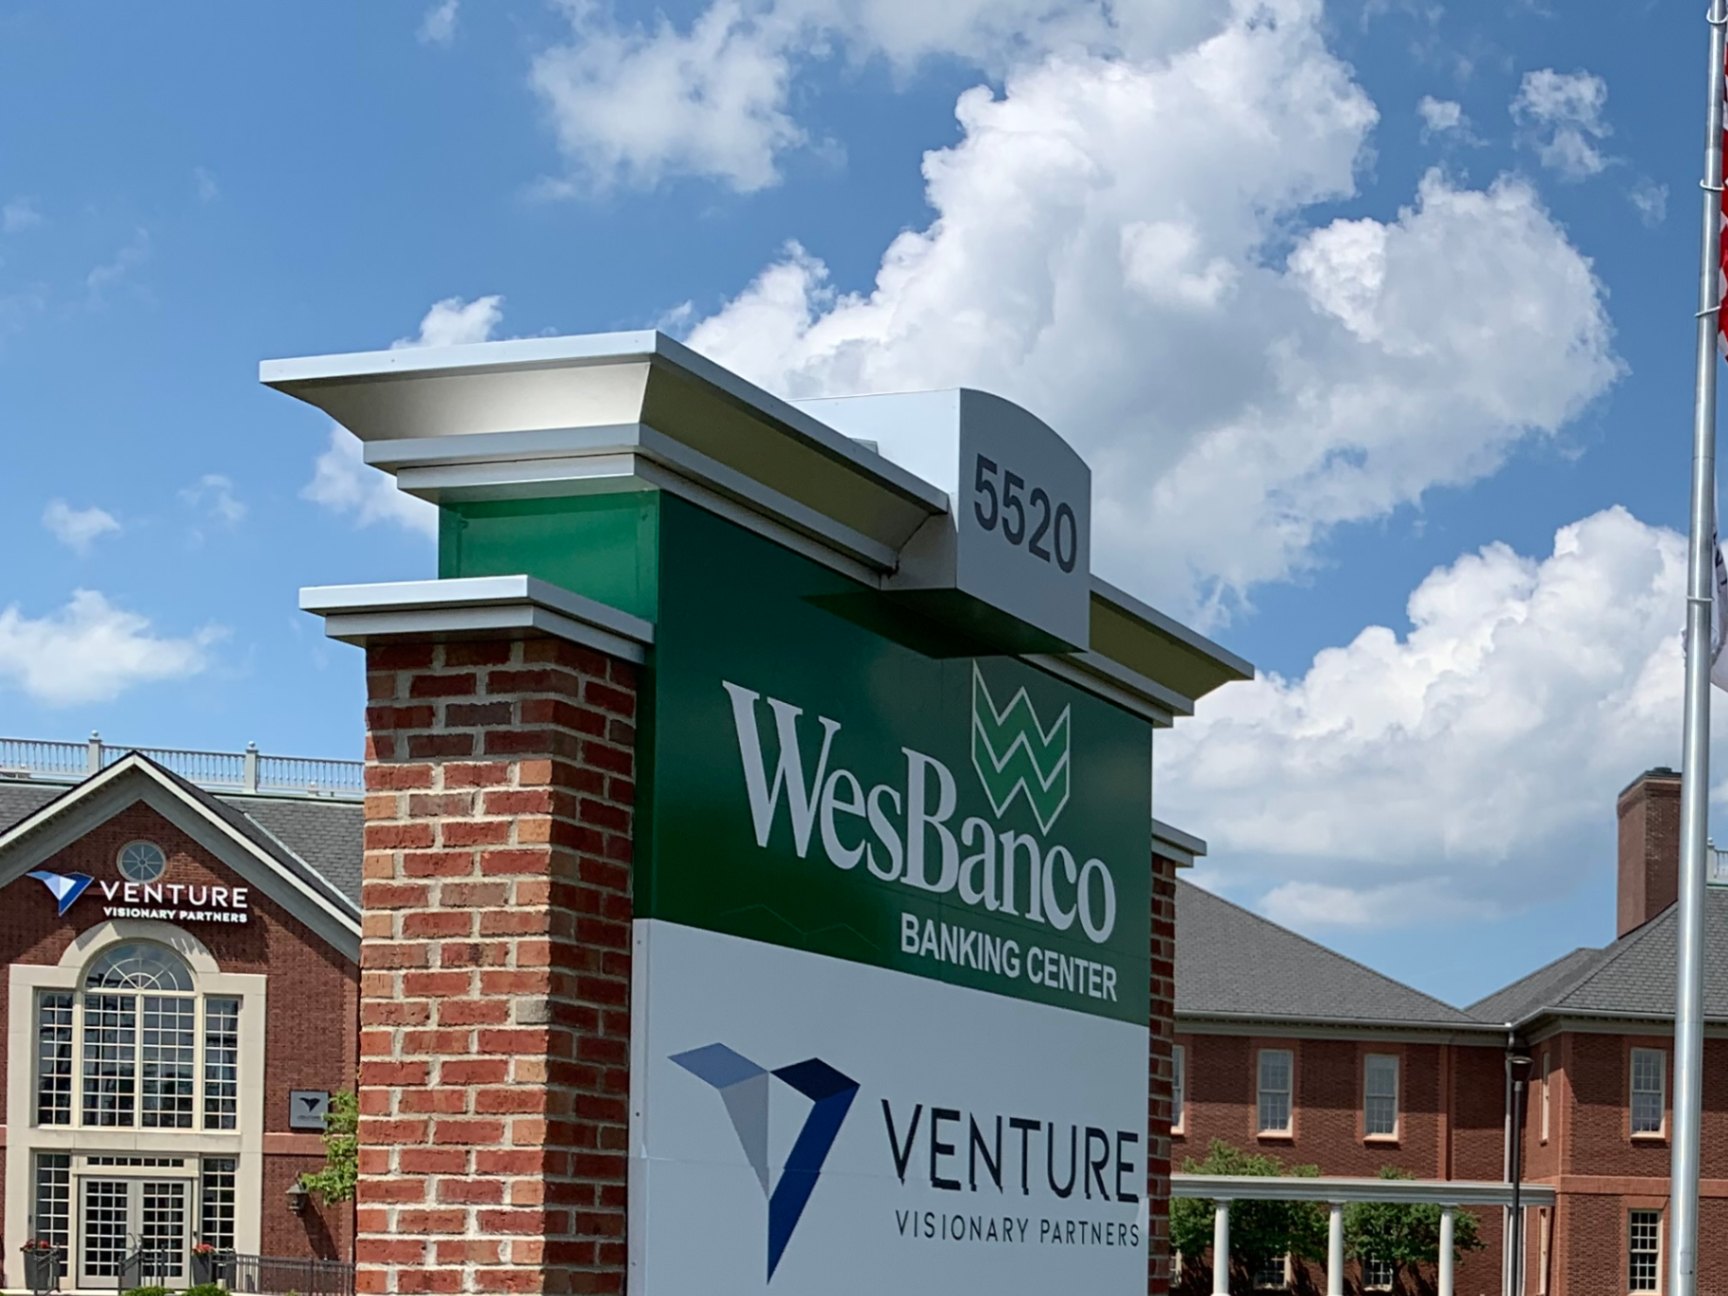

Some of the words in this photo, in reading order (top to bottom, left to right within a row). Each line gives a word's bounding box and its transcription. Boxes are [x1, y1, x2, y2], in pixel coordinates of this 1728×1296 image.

[974, 453, 1077, 574] 5520
[722, 680, 1116, 944] WesBanco
[100, 880, 248, 908] VENTURE
[103, 907, 176, 920] VISIONARY
[179, 910, 248, 923] PARTNERS
[901, 912, 1020, 978] BANKING
[1026, 946, 1118, 1002] CENTER
[881, 1099, 1139, 1203] VENTURE
[895, 1209, 1029, 1243] VISIONARY
[1040, 1218, 1139, 1247] PARTNERS
